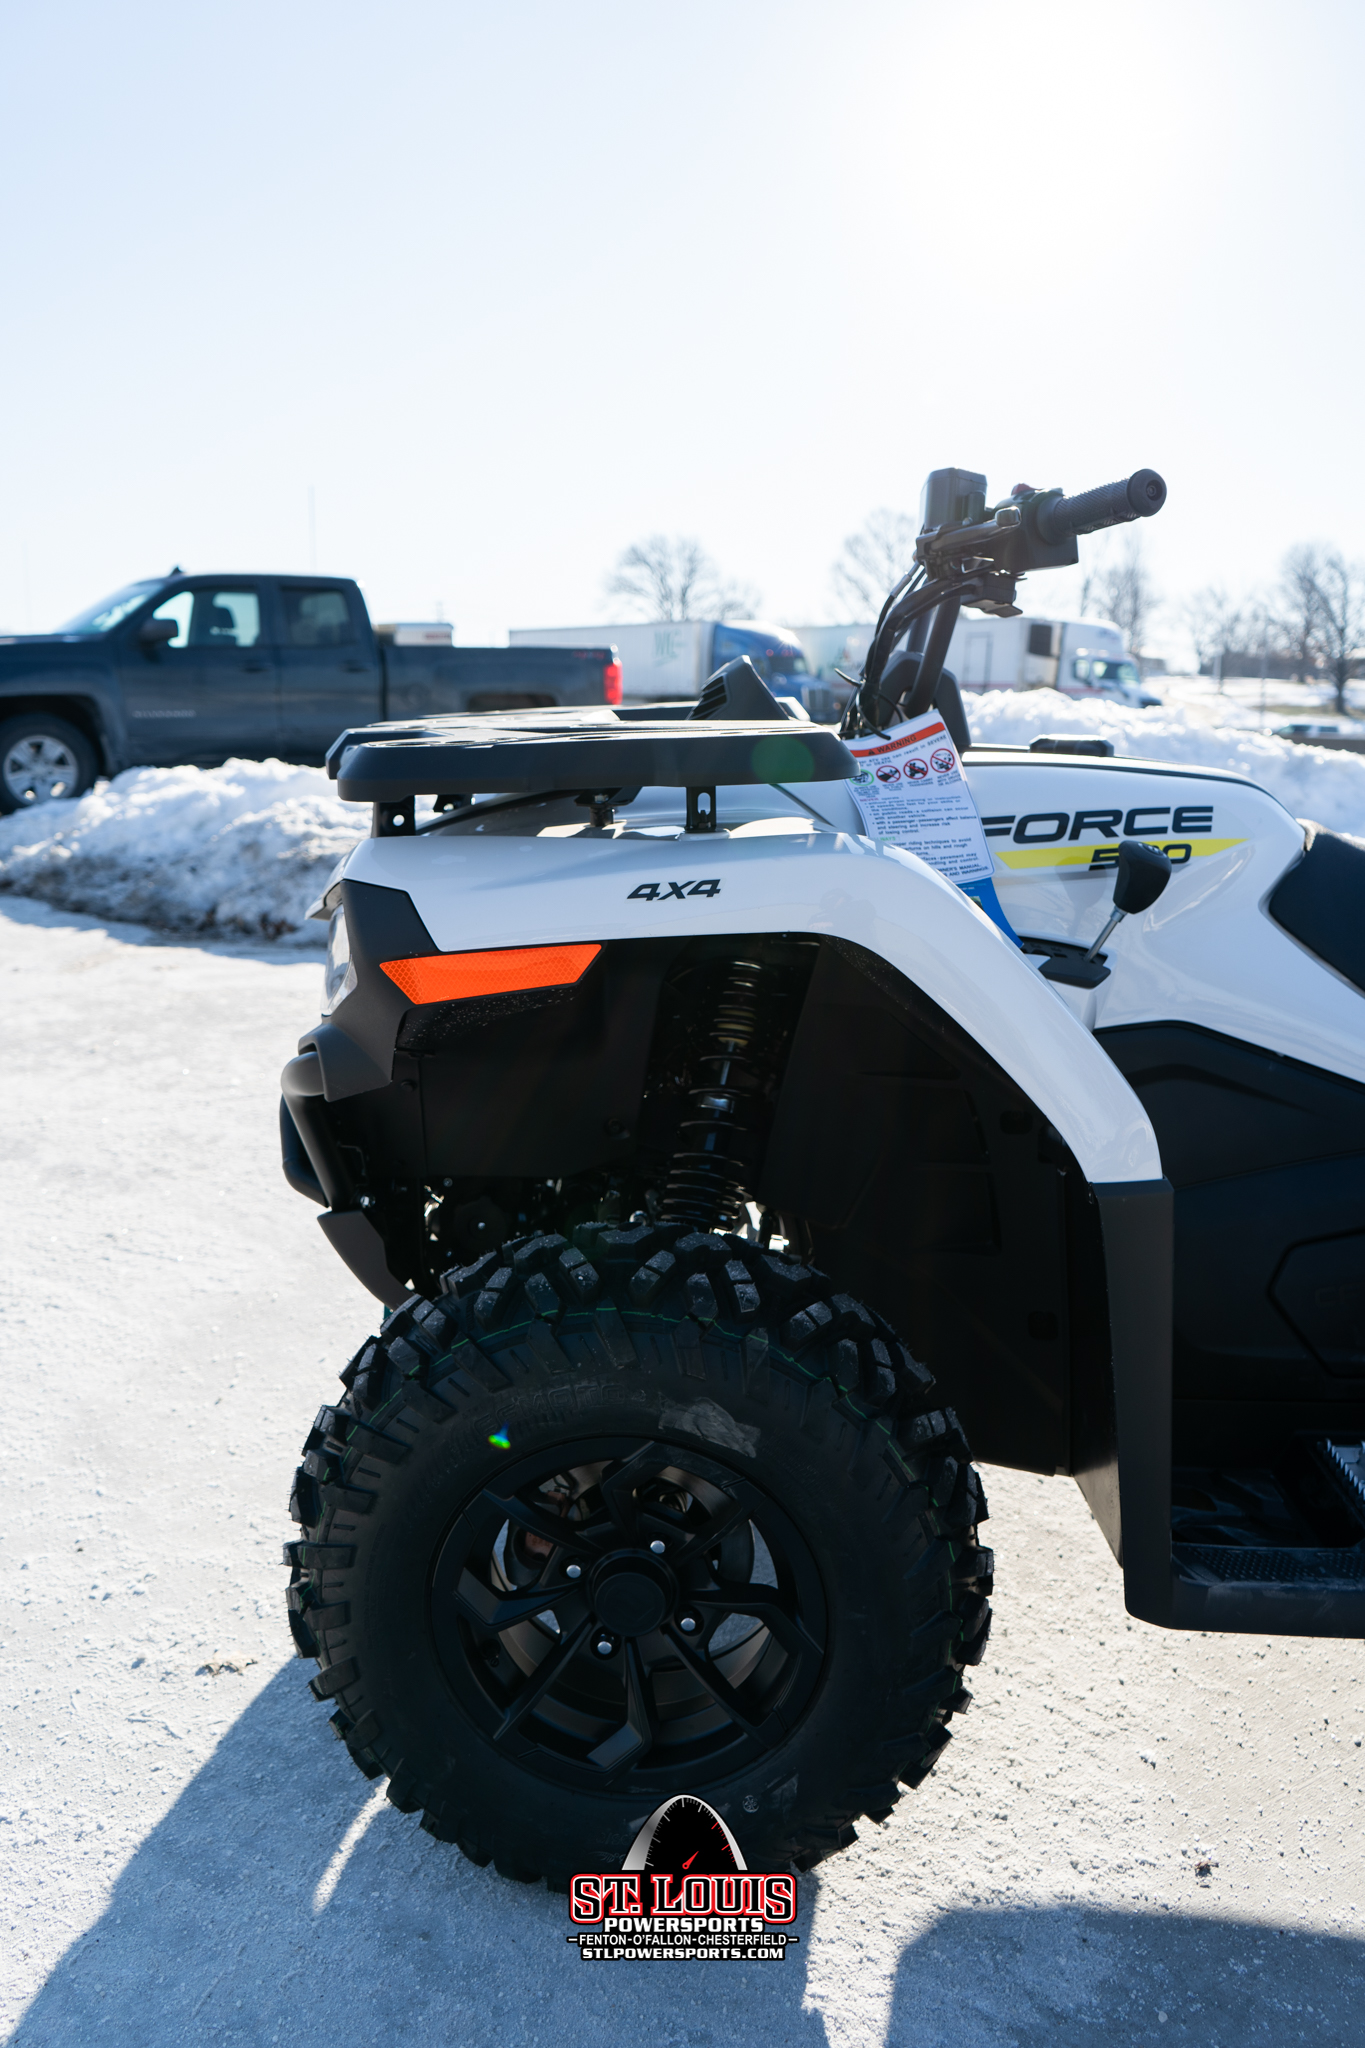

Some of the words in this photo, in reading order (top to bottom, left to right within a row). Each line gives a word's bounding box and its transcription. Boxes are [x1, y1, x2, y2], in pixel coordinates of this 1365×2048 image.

[877, 734, 917, 753] WARNING
[927, 734, 947, 746] SEVERE
[981, 805, 1214, 844] FORCE
[1088, 843, 1192, 871] 50
[627, 879, 721, 901] 4X4
